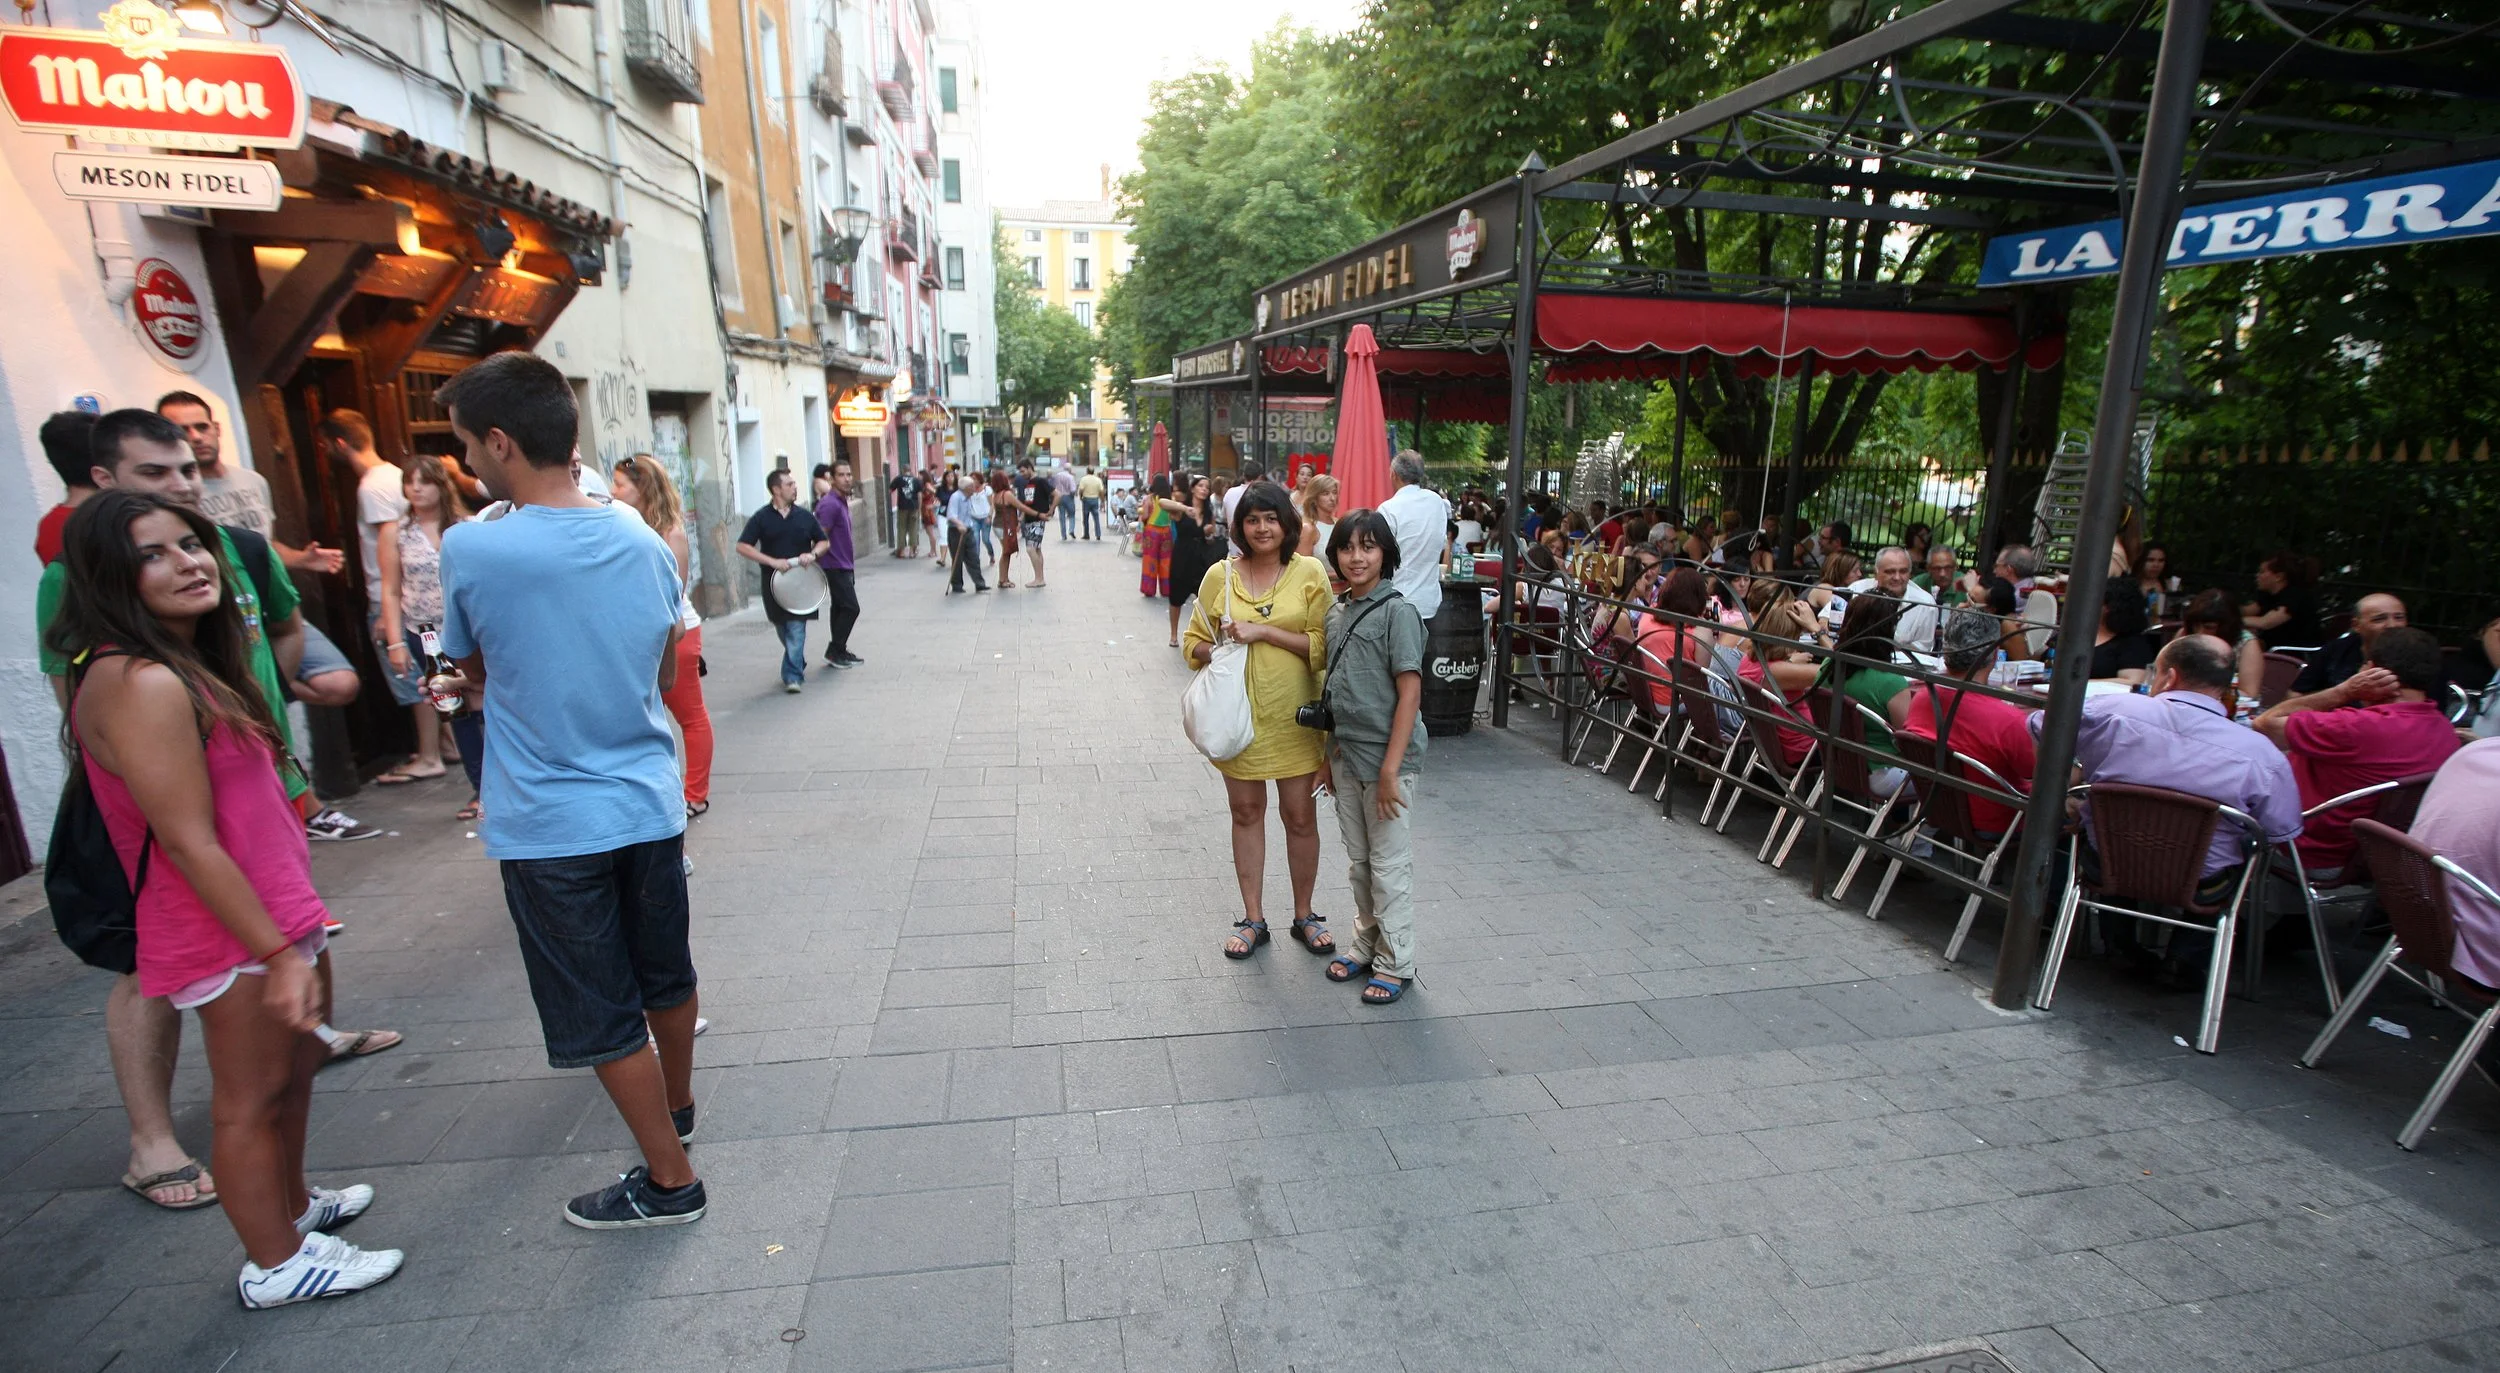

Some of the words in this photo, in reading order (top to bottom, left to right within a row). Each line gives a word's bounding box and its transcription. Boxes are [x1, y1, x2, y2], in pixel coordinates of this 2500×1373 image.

[29, 54, 272, 120] Mahou
[88, 127, 227, 148] CERVEZAS
[81, 166, 170, 190] MESON
[181, 173, 251, 195] FIDEL
[2010, 231, 2118, 278] LA
[1281, 273, 1336, 320] MESON
[1343, 243, 1415, 301] FIDEL
[1431, 656, 1480, 683] Carlsberg
